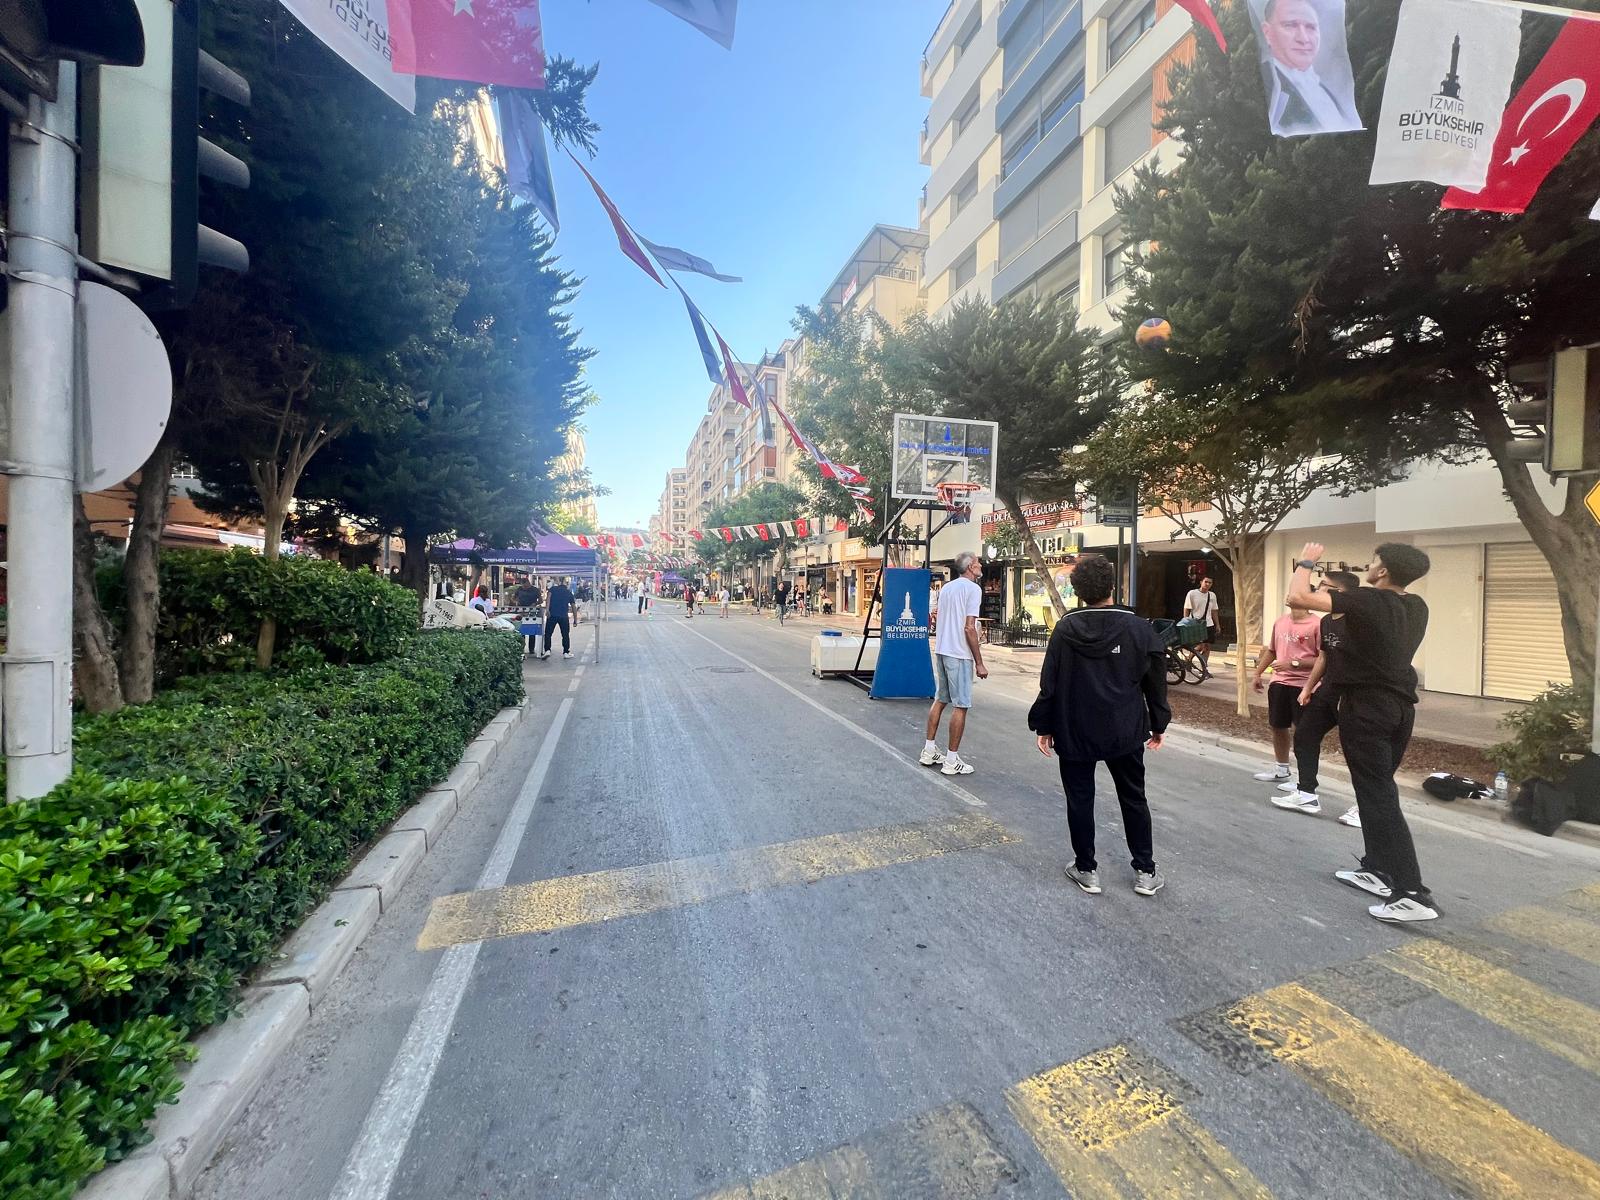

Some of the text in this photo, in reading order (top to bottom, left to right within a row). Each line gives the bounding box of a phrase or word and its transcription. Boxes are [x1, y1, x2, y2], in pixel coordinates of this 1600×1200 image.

[1429, 95, 1464, 115] İZMİR
[1399, 110, 1484, 135] BÜYÜKŞEHİR
[1401, 129, 1478, 151] BELEDİYESİ
[886, 624, 928, 633] BÜYÜKŞEHİR
